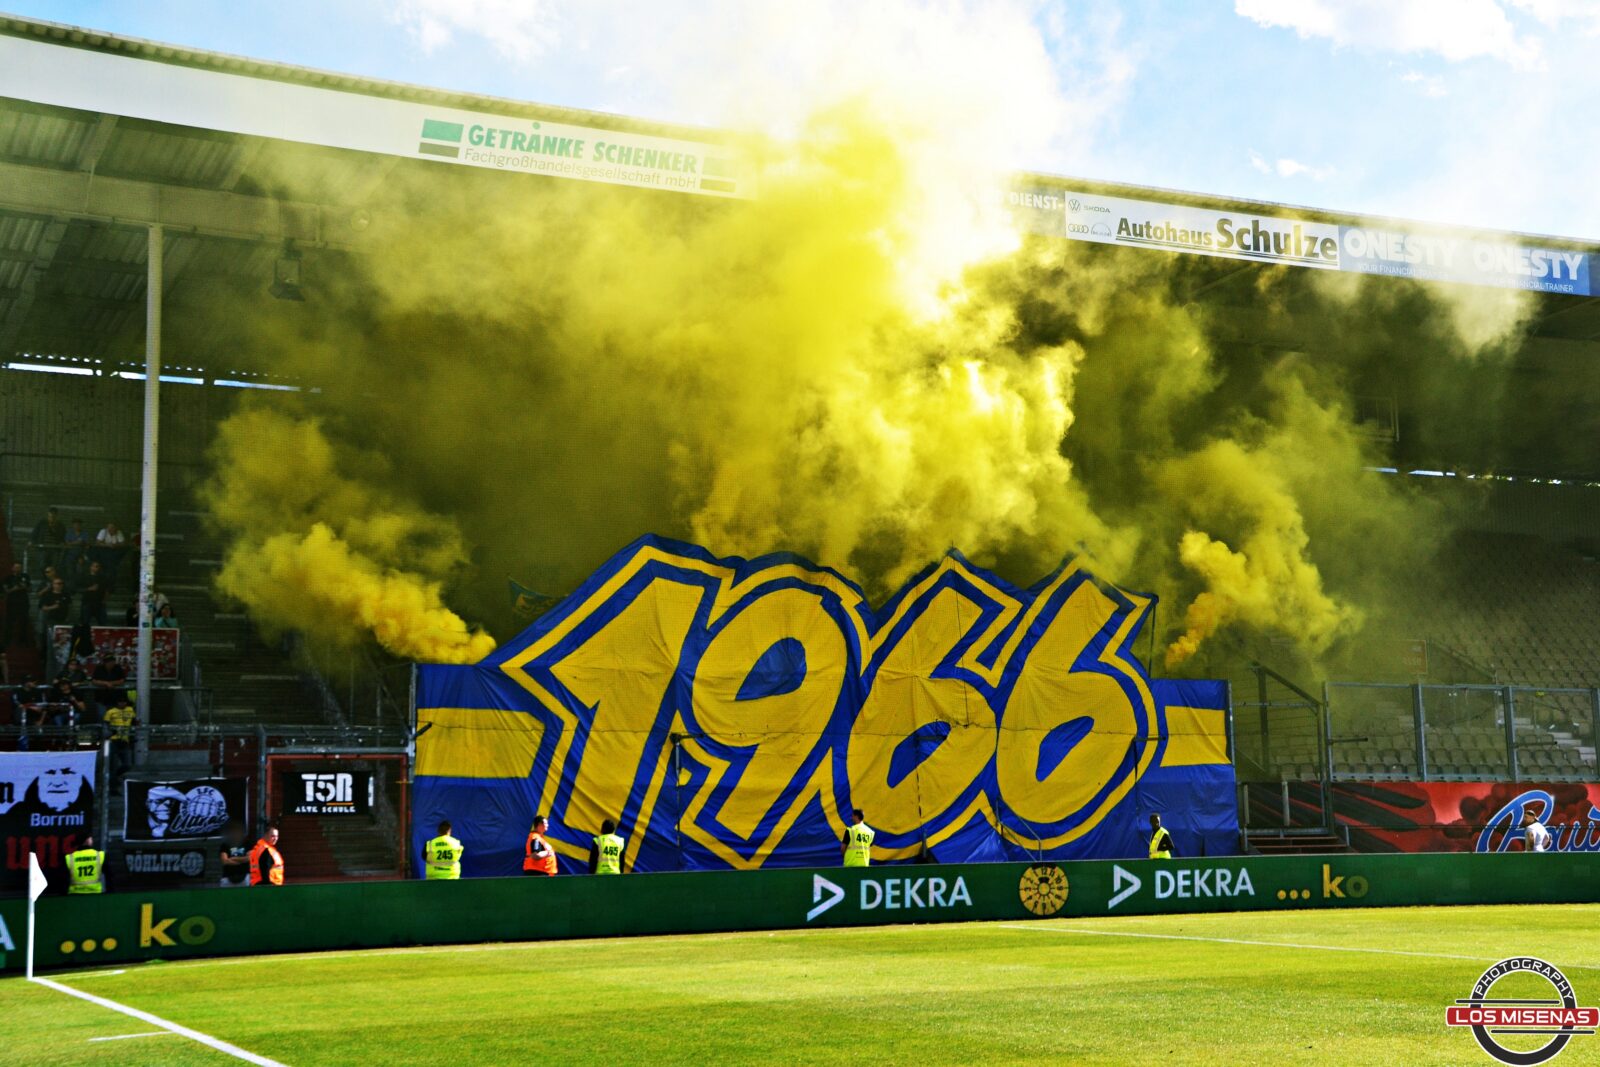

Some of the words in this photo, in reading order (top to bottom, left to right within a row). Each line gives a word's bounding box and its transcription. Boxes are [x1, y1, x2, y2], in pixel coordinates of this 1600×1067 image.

[592, 141, 697, 174] SCHENKER
[665, 174, 697, 189] mbH
[1117, 217, 1212, 247] Autohaus
[1216, 217, 1338, 259] Schulze
[1343, 229, 1458, 268] ONESTY
[1379, 265, 1416, 277] FINANCIAL
[1471, 244, 1584, 281] ONESTY
[1545, 282, 1574, 293] TRAINER
[499, 545, 1157, 866] 1966
[31, 811, 85, 827] Borrmi
[77, 865, 95, 877] 112
[436, 850, 453, 860] 245
[860, 876, 973, 910] DEKRA
[1155, 867, 1255, 899] DEKRA
